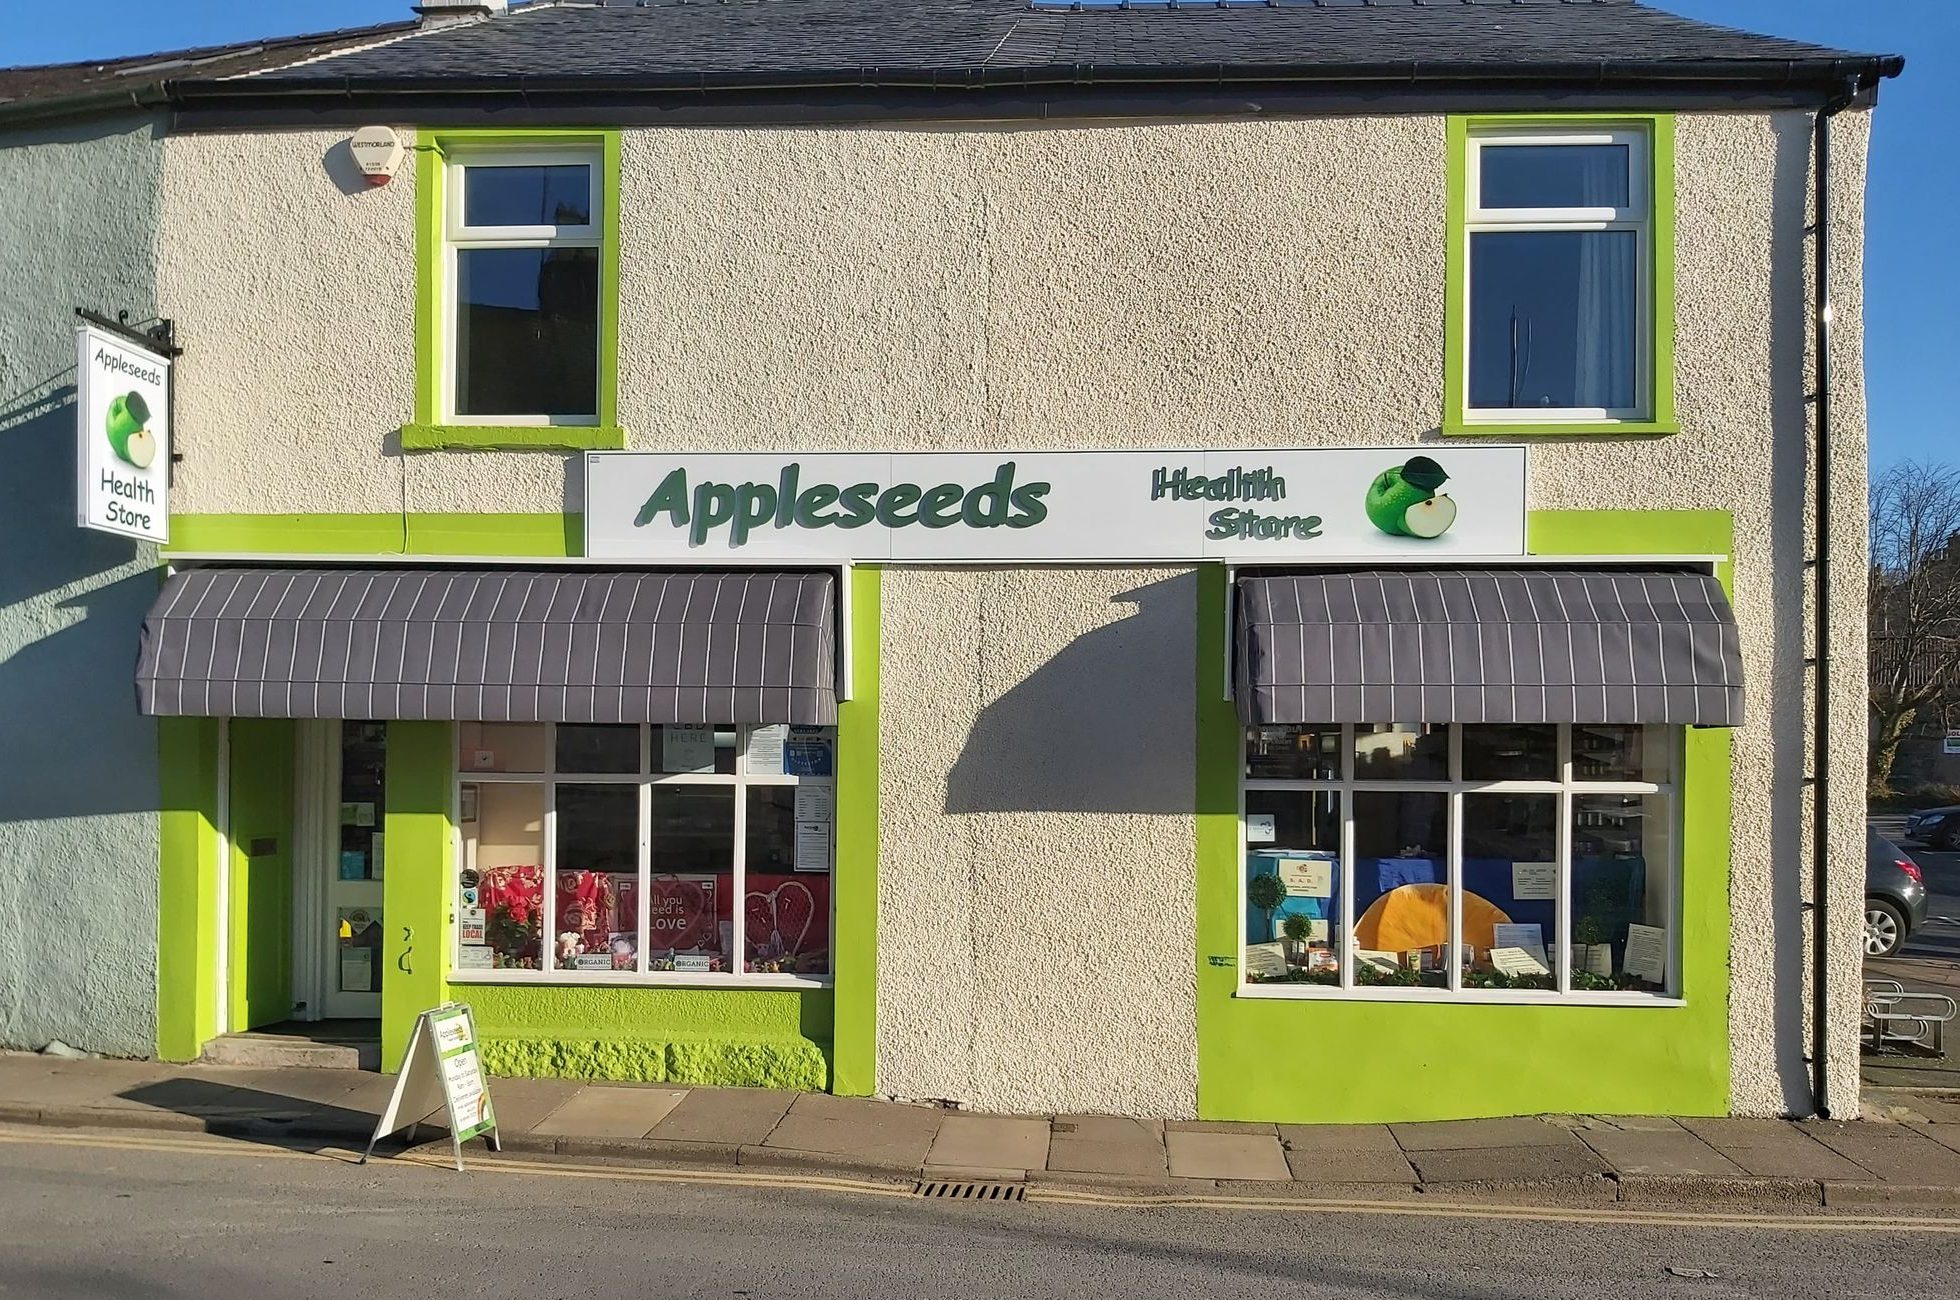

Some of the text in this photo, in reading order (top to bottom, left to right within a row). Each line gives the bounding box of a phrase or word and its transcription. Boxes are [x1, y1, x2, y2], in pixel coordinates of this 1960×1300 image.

[95, 347, 161, 386] Appleseeds
[101, 468, 155, 505] Health
[1151, 466, 1287, 502] Health
[634, 461, 1051, 549] Appleseeds
[105, 501, 151, 530] Store
[1205, 507, 1323, 541] Store
[670, 733, 706, 744] HERE
[651, 904, 685, 915] eed is
[663, 896, 683, 907] you
[462, 930, 484, 939] LOCAL
[577, 958, 611, 966] ORGANIC
[675, 960, 710, 968] ORGANIC
